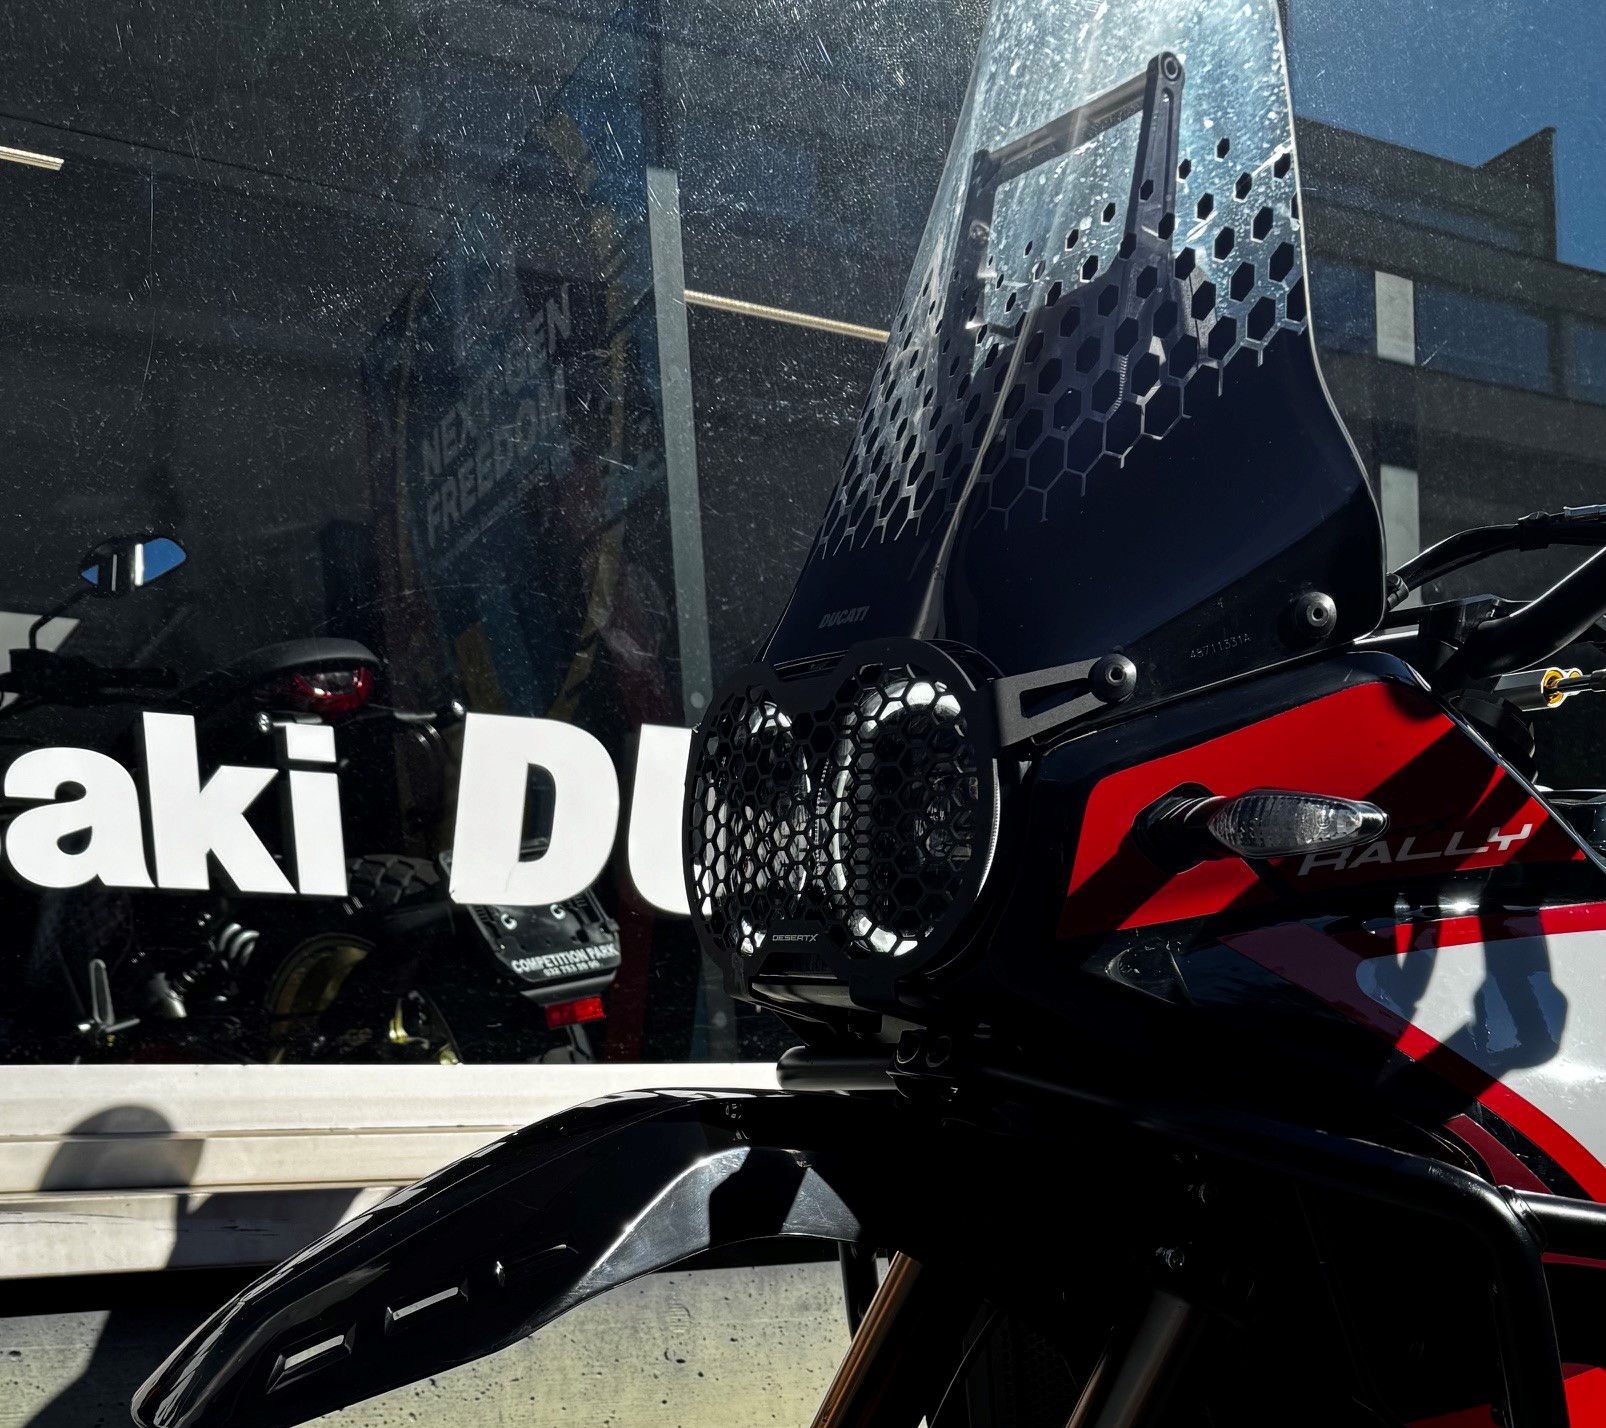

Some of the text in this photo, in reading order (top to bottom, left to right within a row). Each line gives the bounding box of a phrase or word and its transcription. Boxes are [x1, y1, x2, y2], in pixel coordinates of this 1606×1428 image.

[426, 365, 567, 549] FREEDOM
[817, 605, 871, 630] DUCATI
[0, 711, 348, 897] aki
[1297, 823, 1534, 877] RALLY
[511, 948, 590, 974] COMPETITION
[585, 943, 620, 960] PARK
[772, 933, 819, 942] DESERTX
